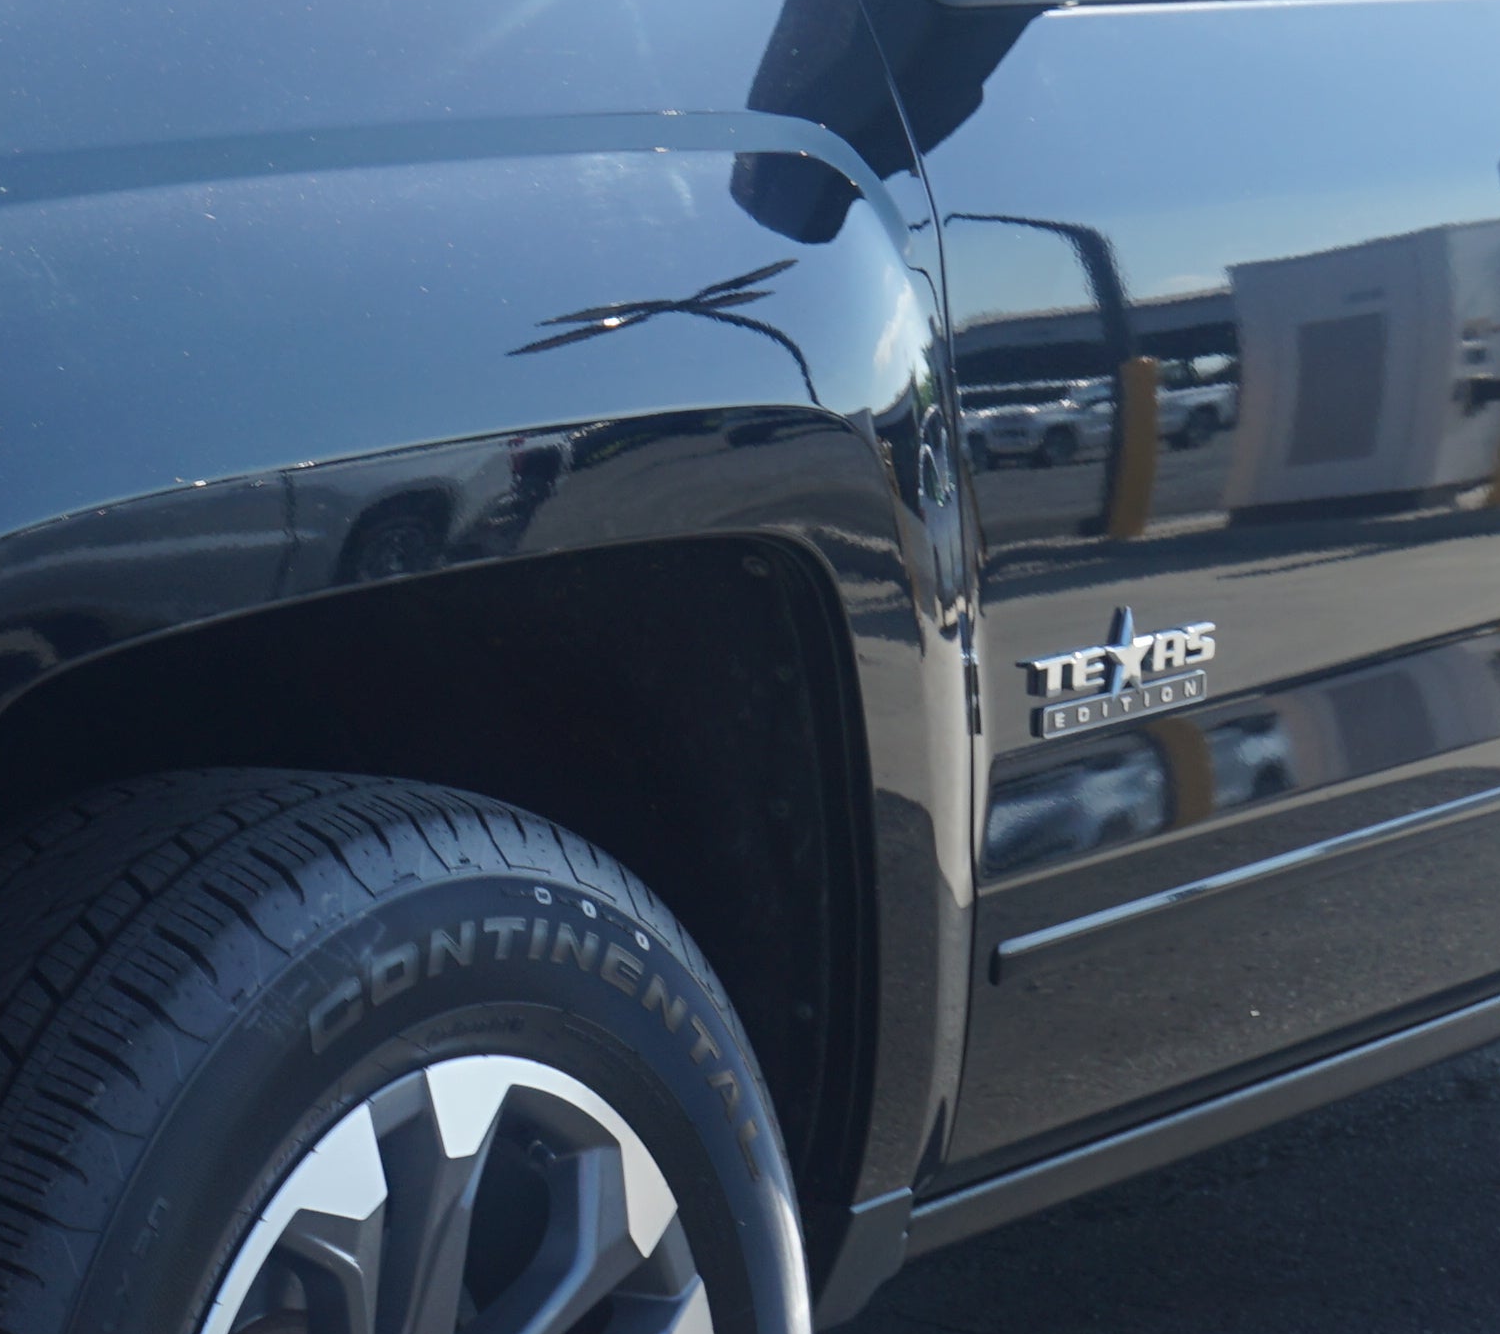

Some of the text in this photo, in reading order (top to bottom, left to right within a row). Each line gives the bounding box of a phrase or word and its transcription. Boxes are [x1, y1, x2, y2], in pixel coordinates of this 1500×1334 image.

[1030, 606, 1217, 701] TEXAS
[1053, 678, 1199, 729] EDITION
[307, 916, 764, 1182] CONTINENTAL
